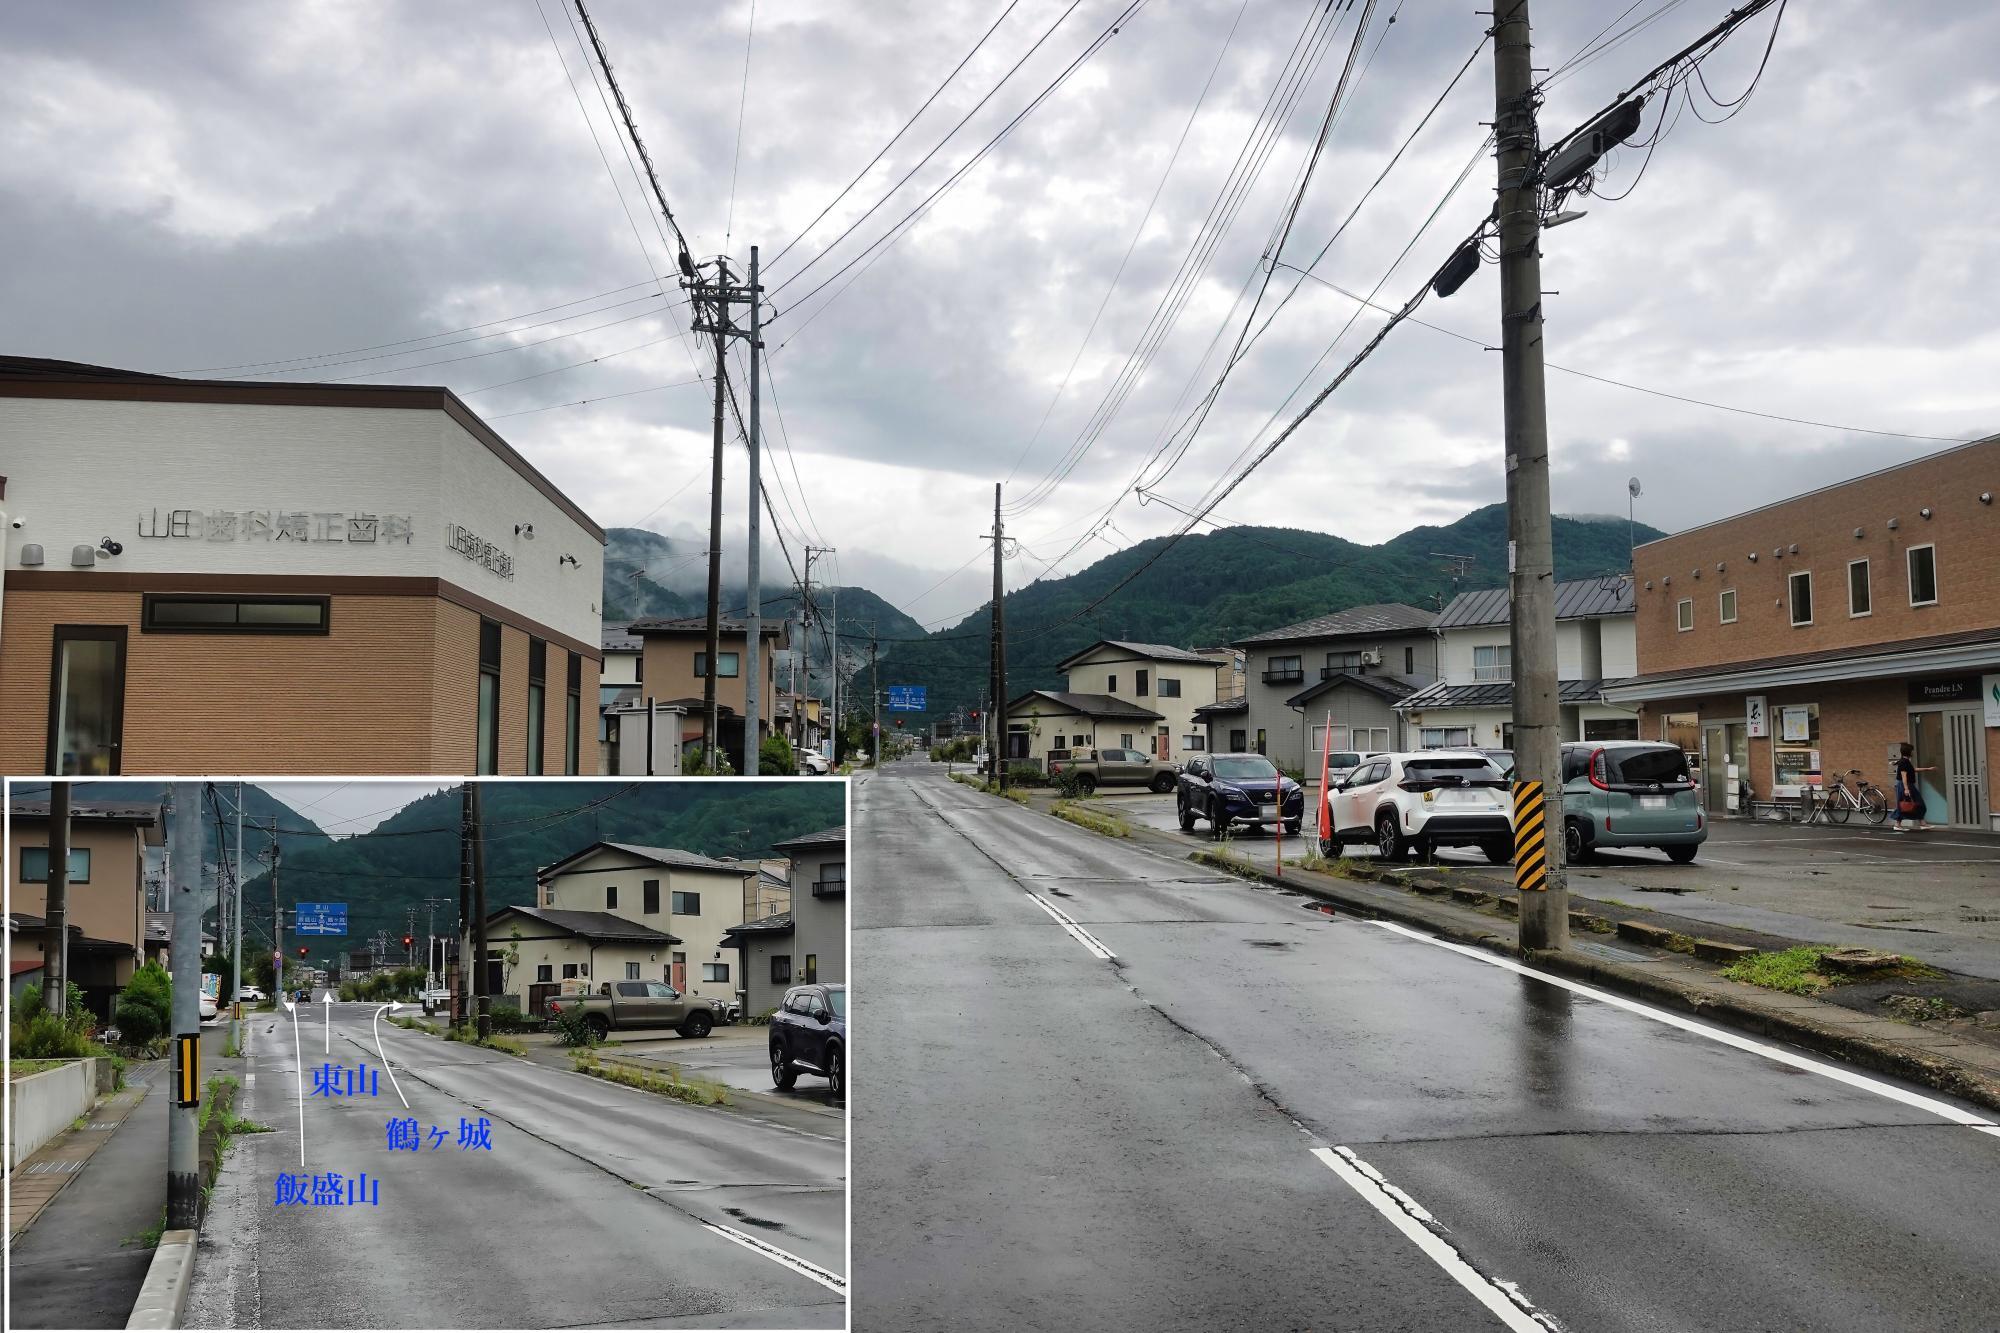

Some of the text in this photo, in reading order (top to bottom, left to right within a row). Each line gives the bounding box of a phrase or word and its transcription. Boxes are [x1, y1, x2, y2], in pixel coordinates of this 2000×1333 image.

[138, 507, 414, 545] 山田歯科矯正歯科
[446, 522, 515, 583] 山田歯科矯正歯科
